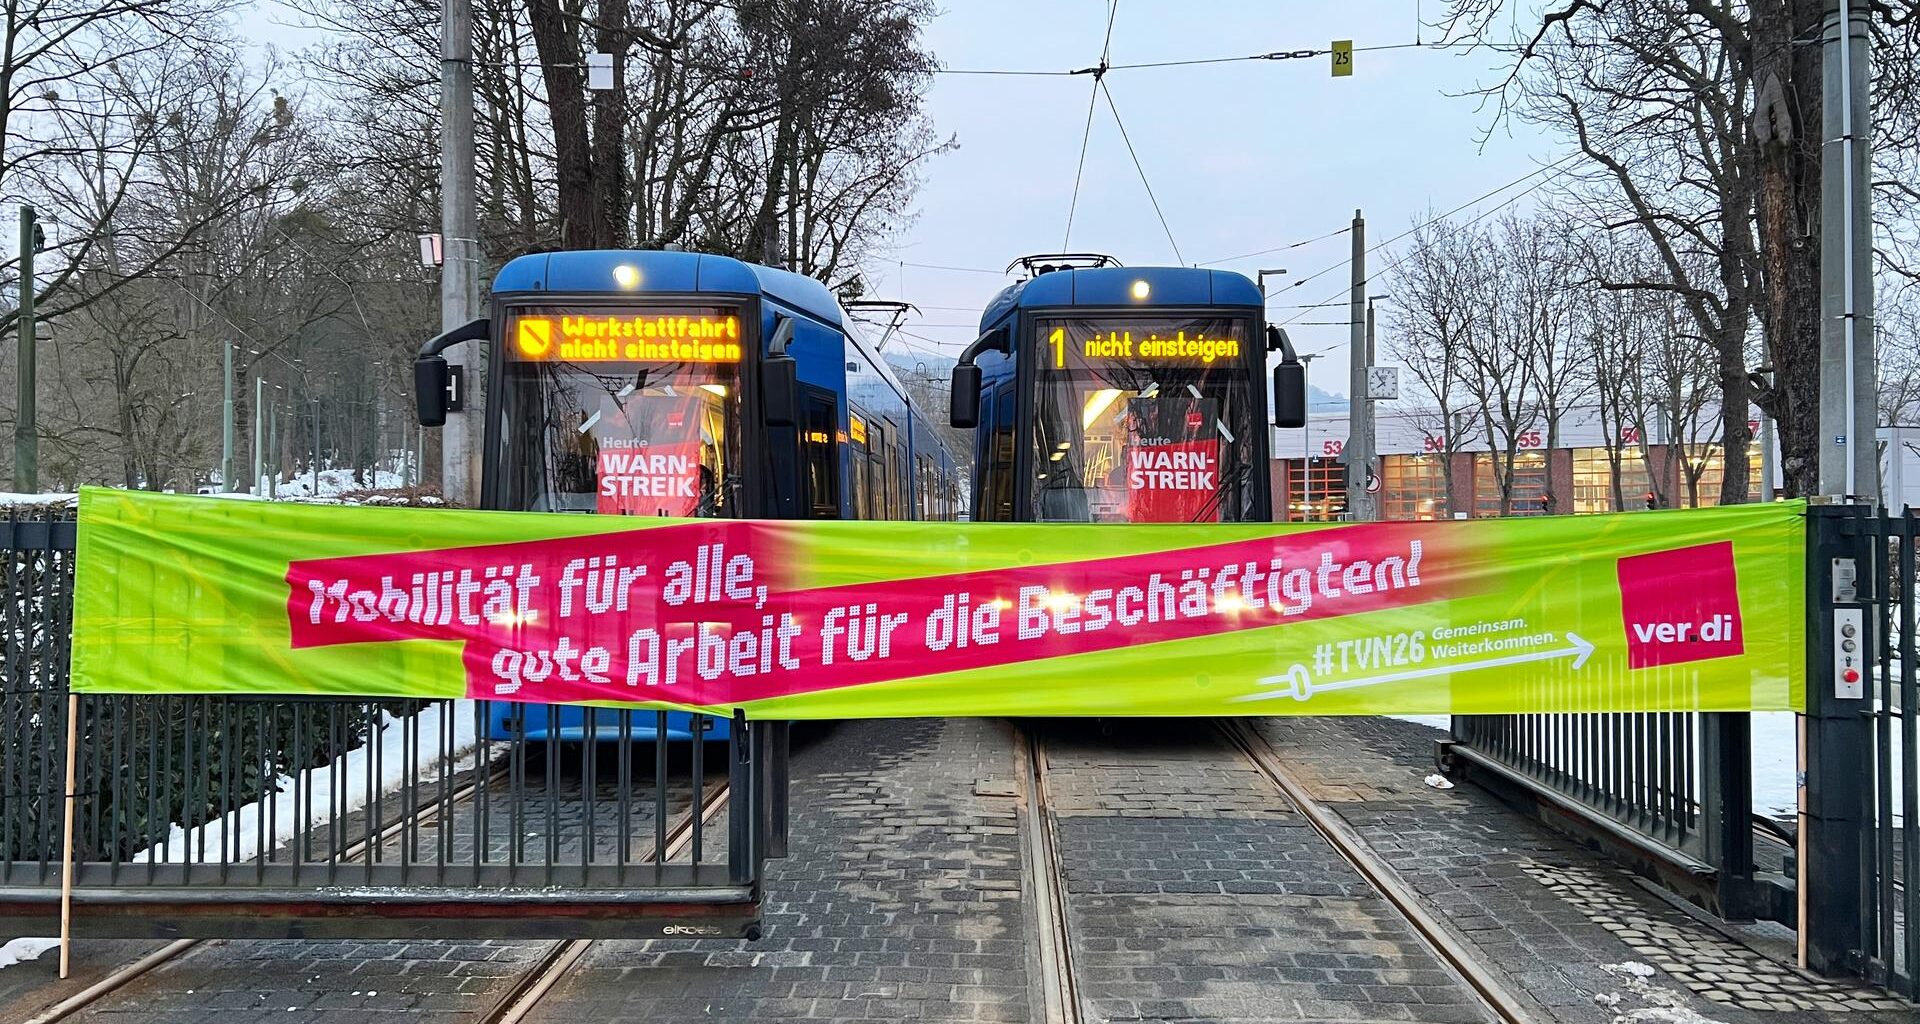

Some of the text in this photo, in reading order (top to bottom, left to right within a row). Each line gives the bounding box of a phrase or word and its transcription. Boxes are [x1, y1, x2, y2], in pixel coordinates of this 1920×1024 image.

[1335, 51, 1349, 65] 25
[562, 315, 737, 339] Werkstattfahrt
[560, 338, 740, 361] nicht einsteigen
[1049, 328, 1239, 369] 1 nicht einsteigen
[602, 436, 648, 450] Heute
[1323, 440, 1343, 456] 53
[1424, 436, 1445, 452] 54
[1519, 431, 1542, 448] 55
[602, 454, 696, 475] WARN-
[1131, 451, 1215, 471] WARN-
[601, 476, 695, 498] STREIK
[1131, 471, 1215, 491] STREIK
[307, 543, 768, 627] Mobilität für alle,
[491, 539, 1423, 695] gute Arbeit für die Beschäftigten!
[1431, 615, 1529, 642] Gemeinsam.
[1632, 612, 1734, 645] ver.di
[1312, 630, 1426, 677] #TVN26
[1431, 629, 1559, 660] Weiterkommen.
